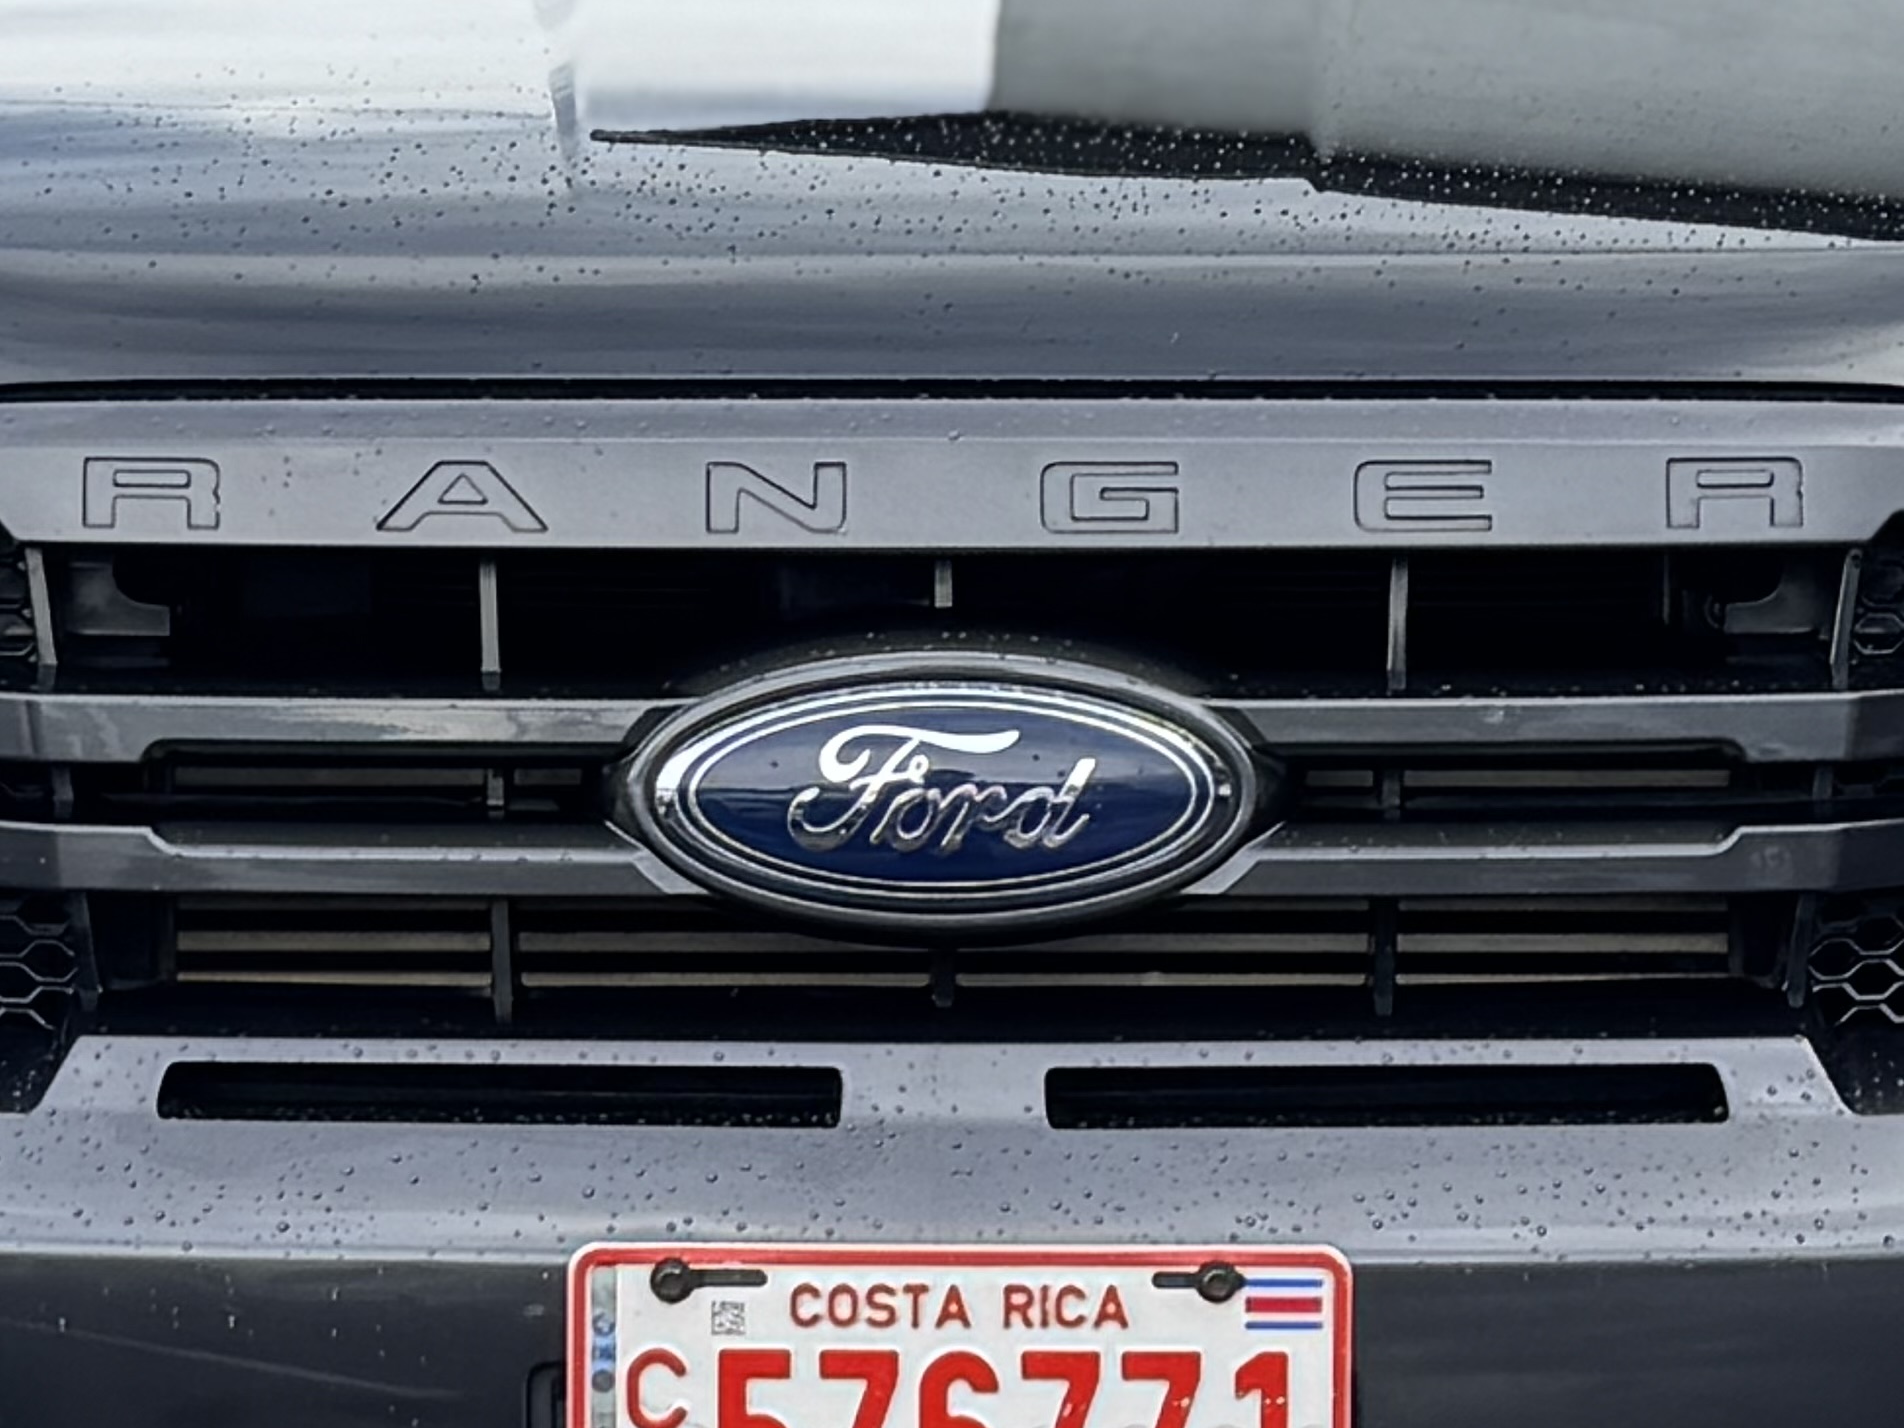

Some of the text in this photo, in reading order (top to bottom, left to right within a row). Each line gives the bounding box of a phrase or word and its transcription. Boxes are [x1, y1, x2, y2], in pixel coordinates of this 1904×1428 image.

[80, 454, 1807, 536] RANGER
[786, 721, 1099, 852] Ford
[789, 1282, 1130, 1329] COSTA RICA
